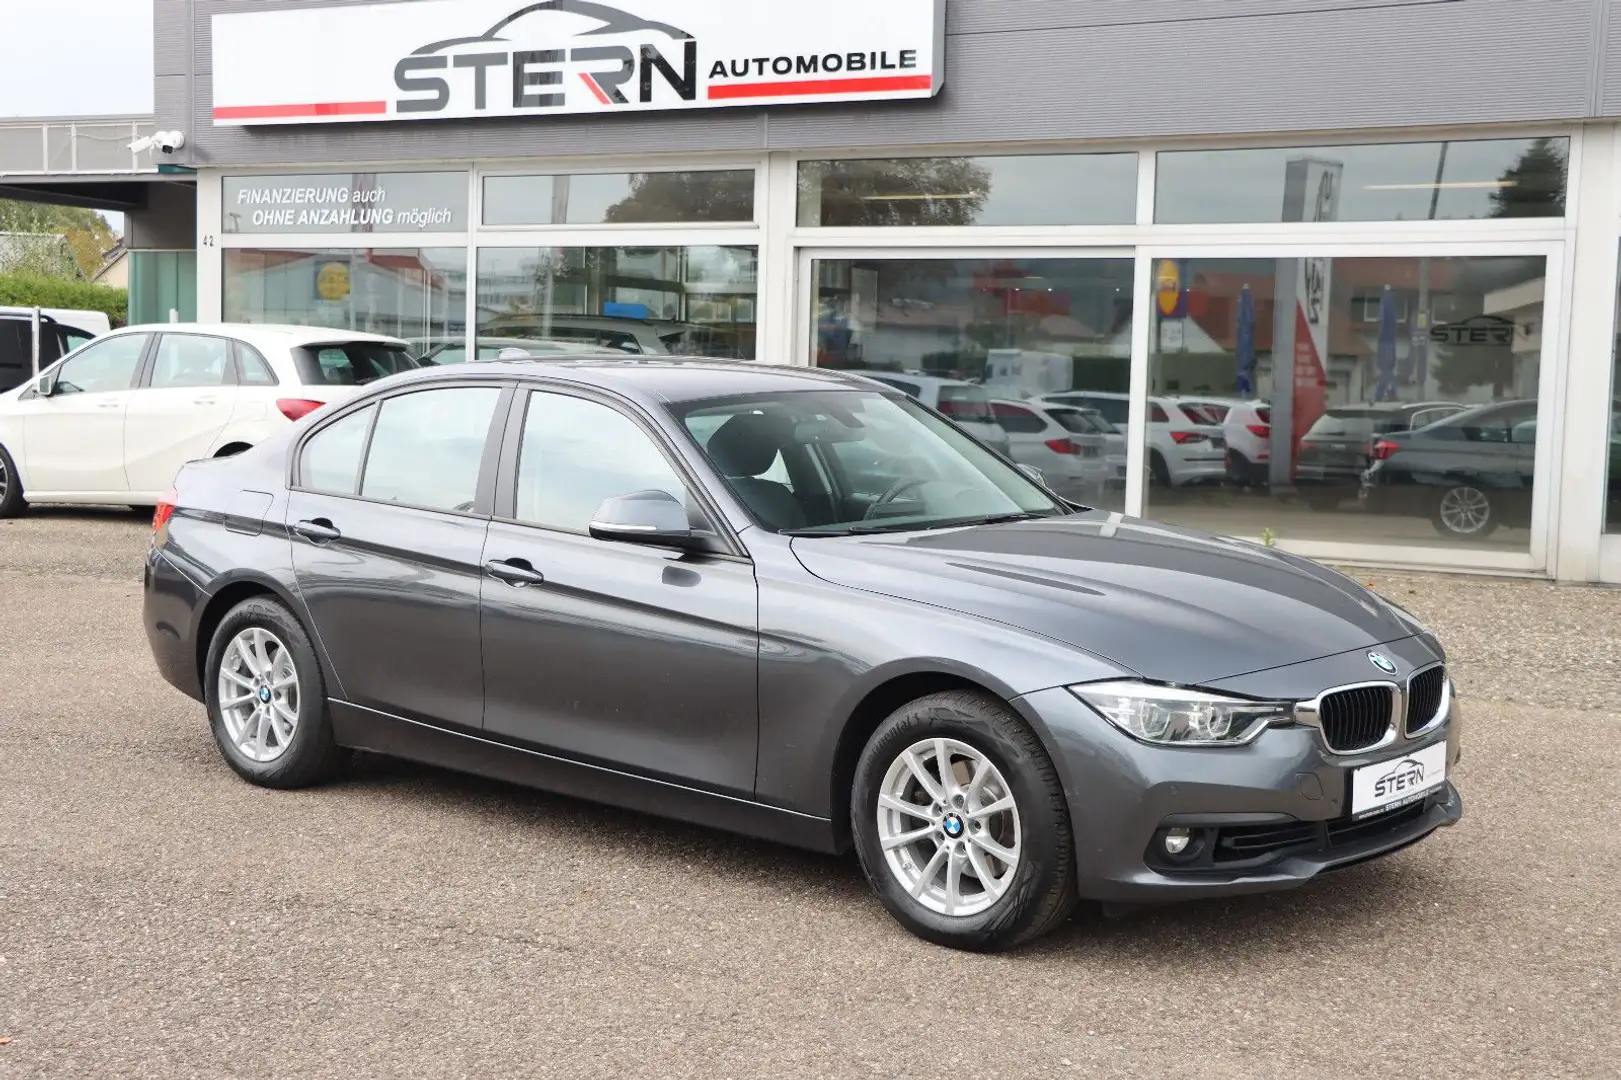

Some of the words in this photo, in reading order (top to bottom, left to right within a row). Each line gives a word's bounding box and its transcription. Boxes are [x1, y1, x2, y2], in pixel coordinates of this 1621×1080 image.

[394, 41, 697, 112] STERN
[709, 49, 917, 79] AUTOMOBILE
[237, 187, 349, 204] FINANZIERUNG
[352, 186, 386, 203] auch
[252, 209, 296, 226] OHNE
[297, 208, 394, 226] ANZAHLUNG
[396, 207, 452, 229] möglich
[203, 235, 214, 247] 42
[1374, 767, 1425, 798] STERN
